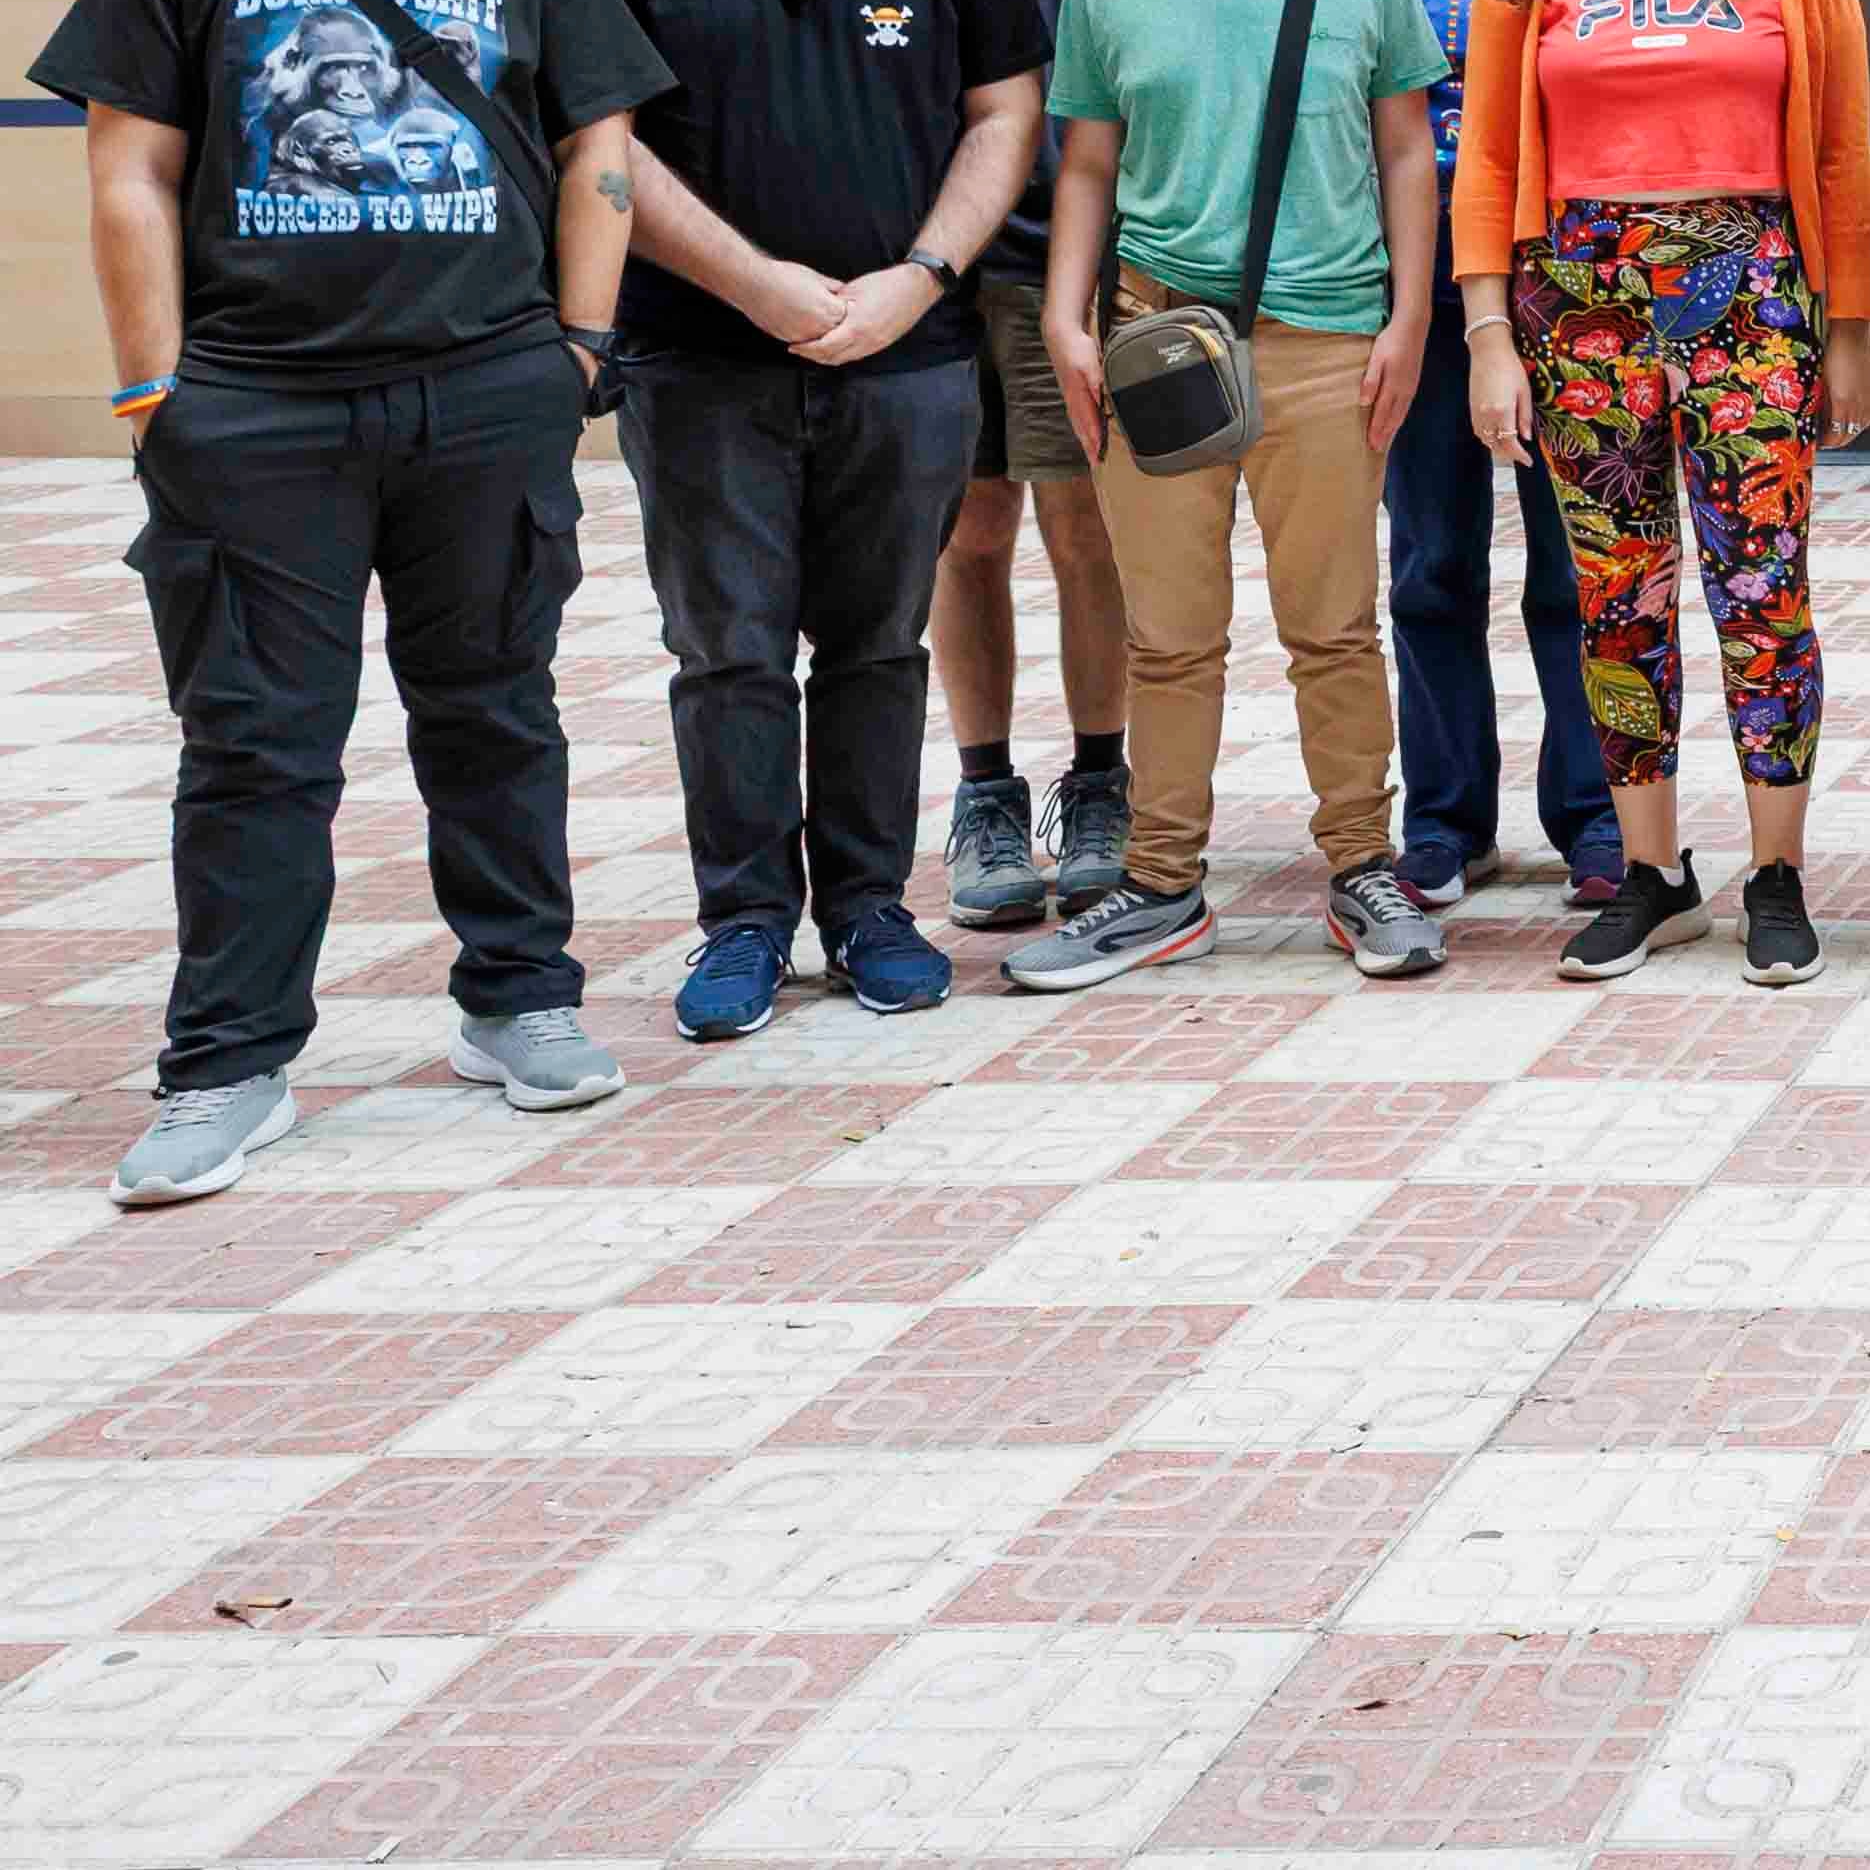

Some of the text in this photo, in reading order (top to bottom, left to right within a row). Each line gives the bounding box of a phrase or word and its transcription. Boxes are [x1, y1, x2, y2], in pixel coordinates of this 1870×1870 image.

[236, 186, 498, 237] FORCED TO WIPE
